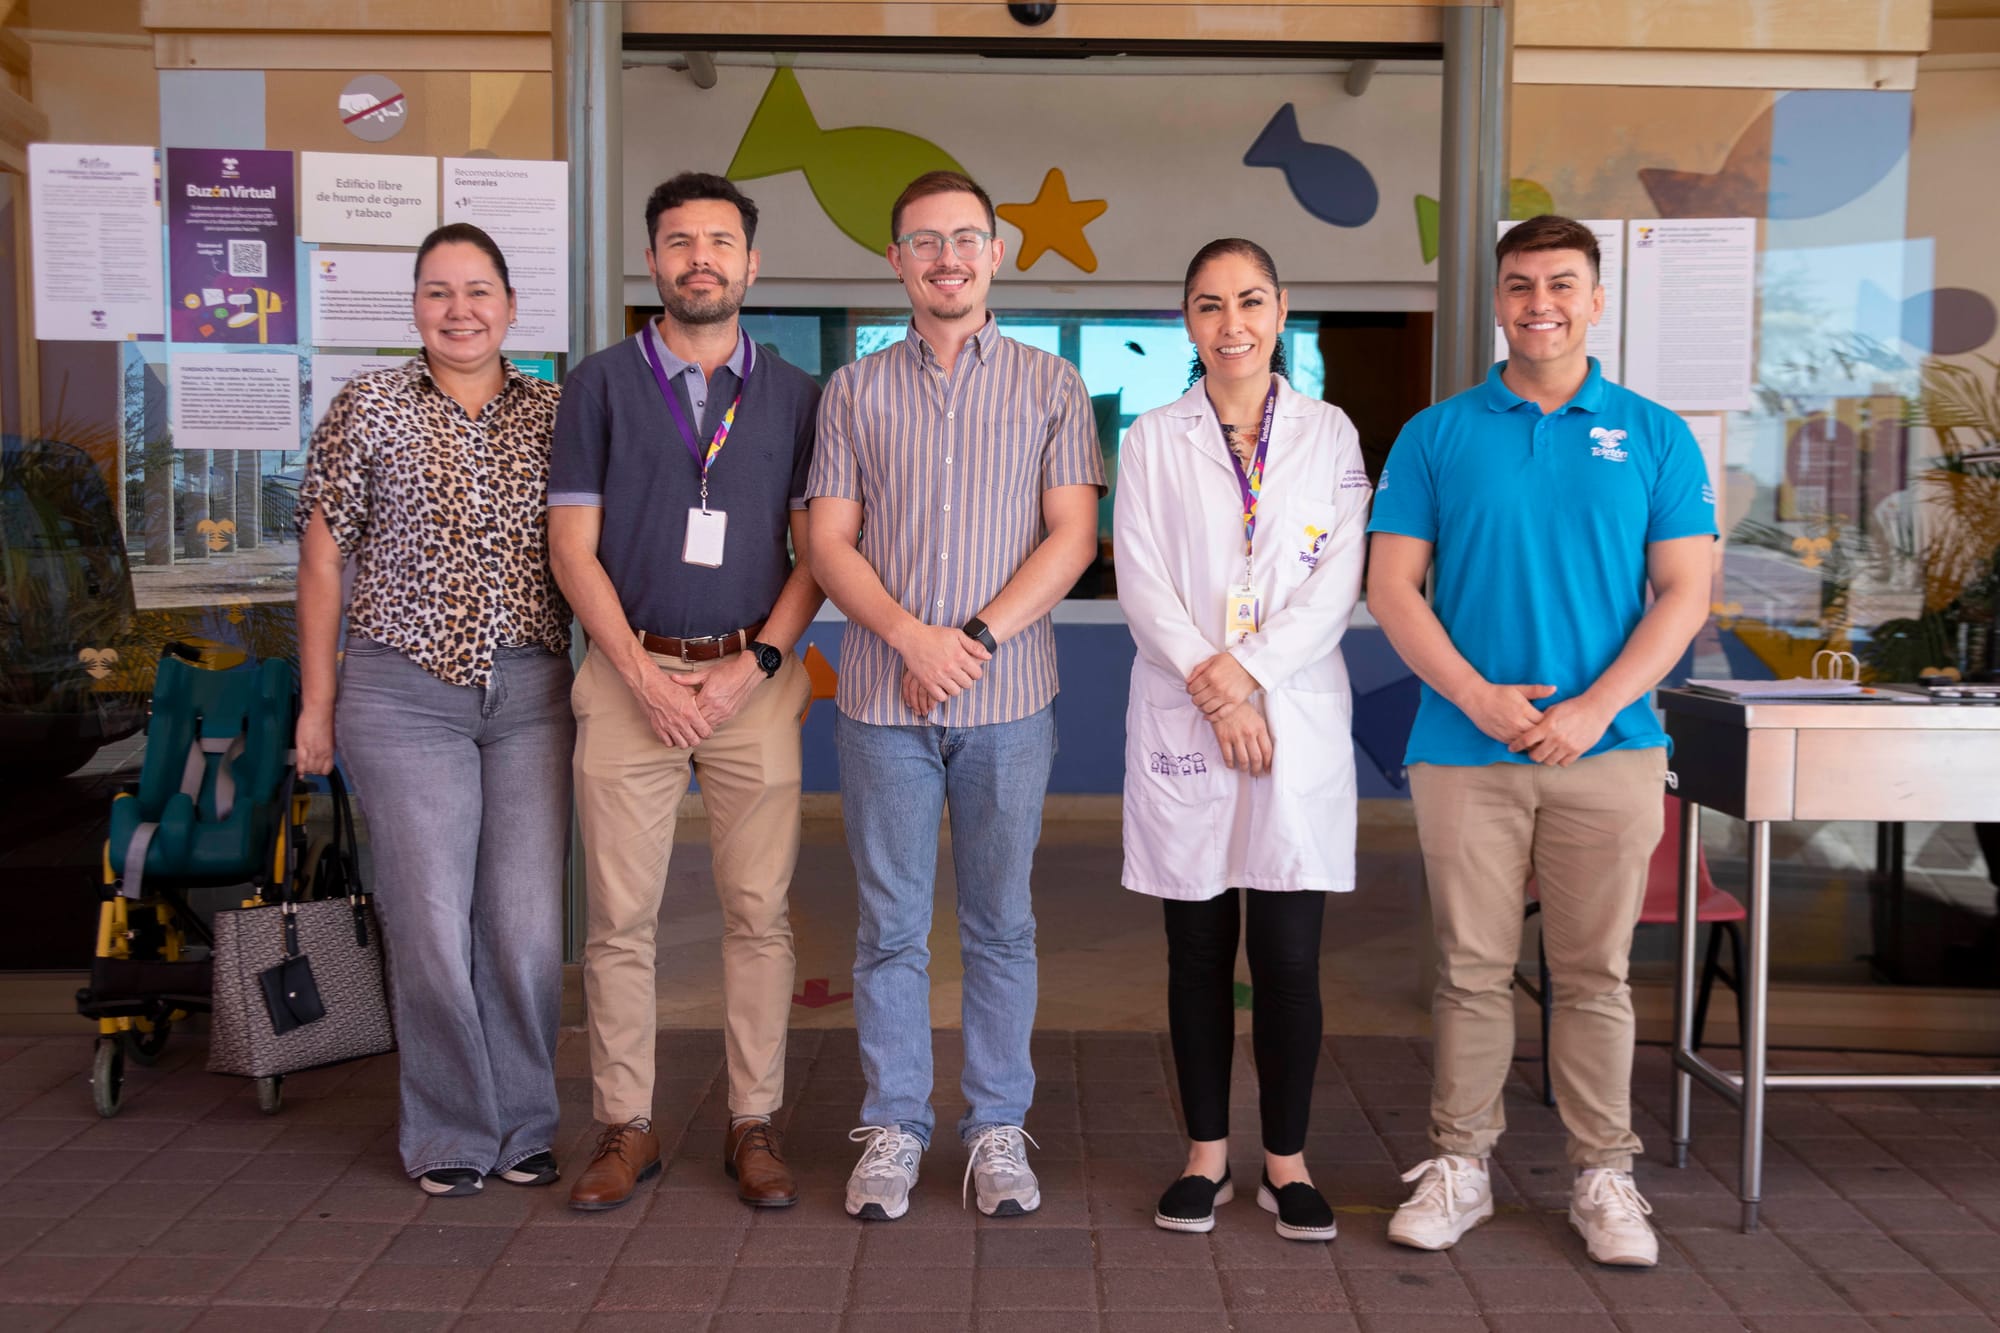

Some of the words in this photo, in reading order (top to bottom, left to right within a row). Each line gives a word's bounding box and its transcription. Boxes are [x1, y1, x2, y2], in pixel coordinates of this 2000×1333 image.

[454, 168, 528, 178] Recomendaciones
[335, 178, 376, 190] Edificio
[377, 180, 403, 191] libre
[454, 178, 498, 187] Generales
[186, 184, 230, 198] Buzón
[230, 185, 276, 199] Virtual
[316, 192, 330, 202] de
[332, 192, 365, 204] humo
[367, 194, 382, 204] de
[383, 195, 422, 207] cigarro
[346, 209, 353, 219] y
[354, 208, 392, 219] tabaco
[1260, 414, 1272, 443] Fundación
